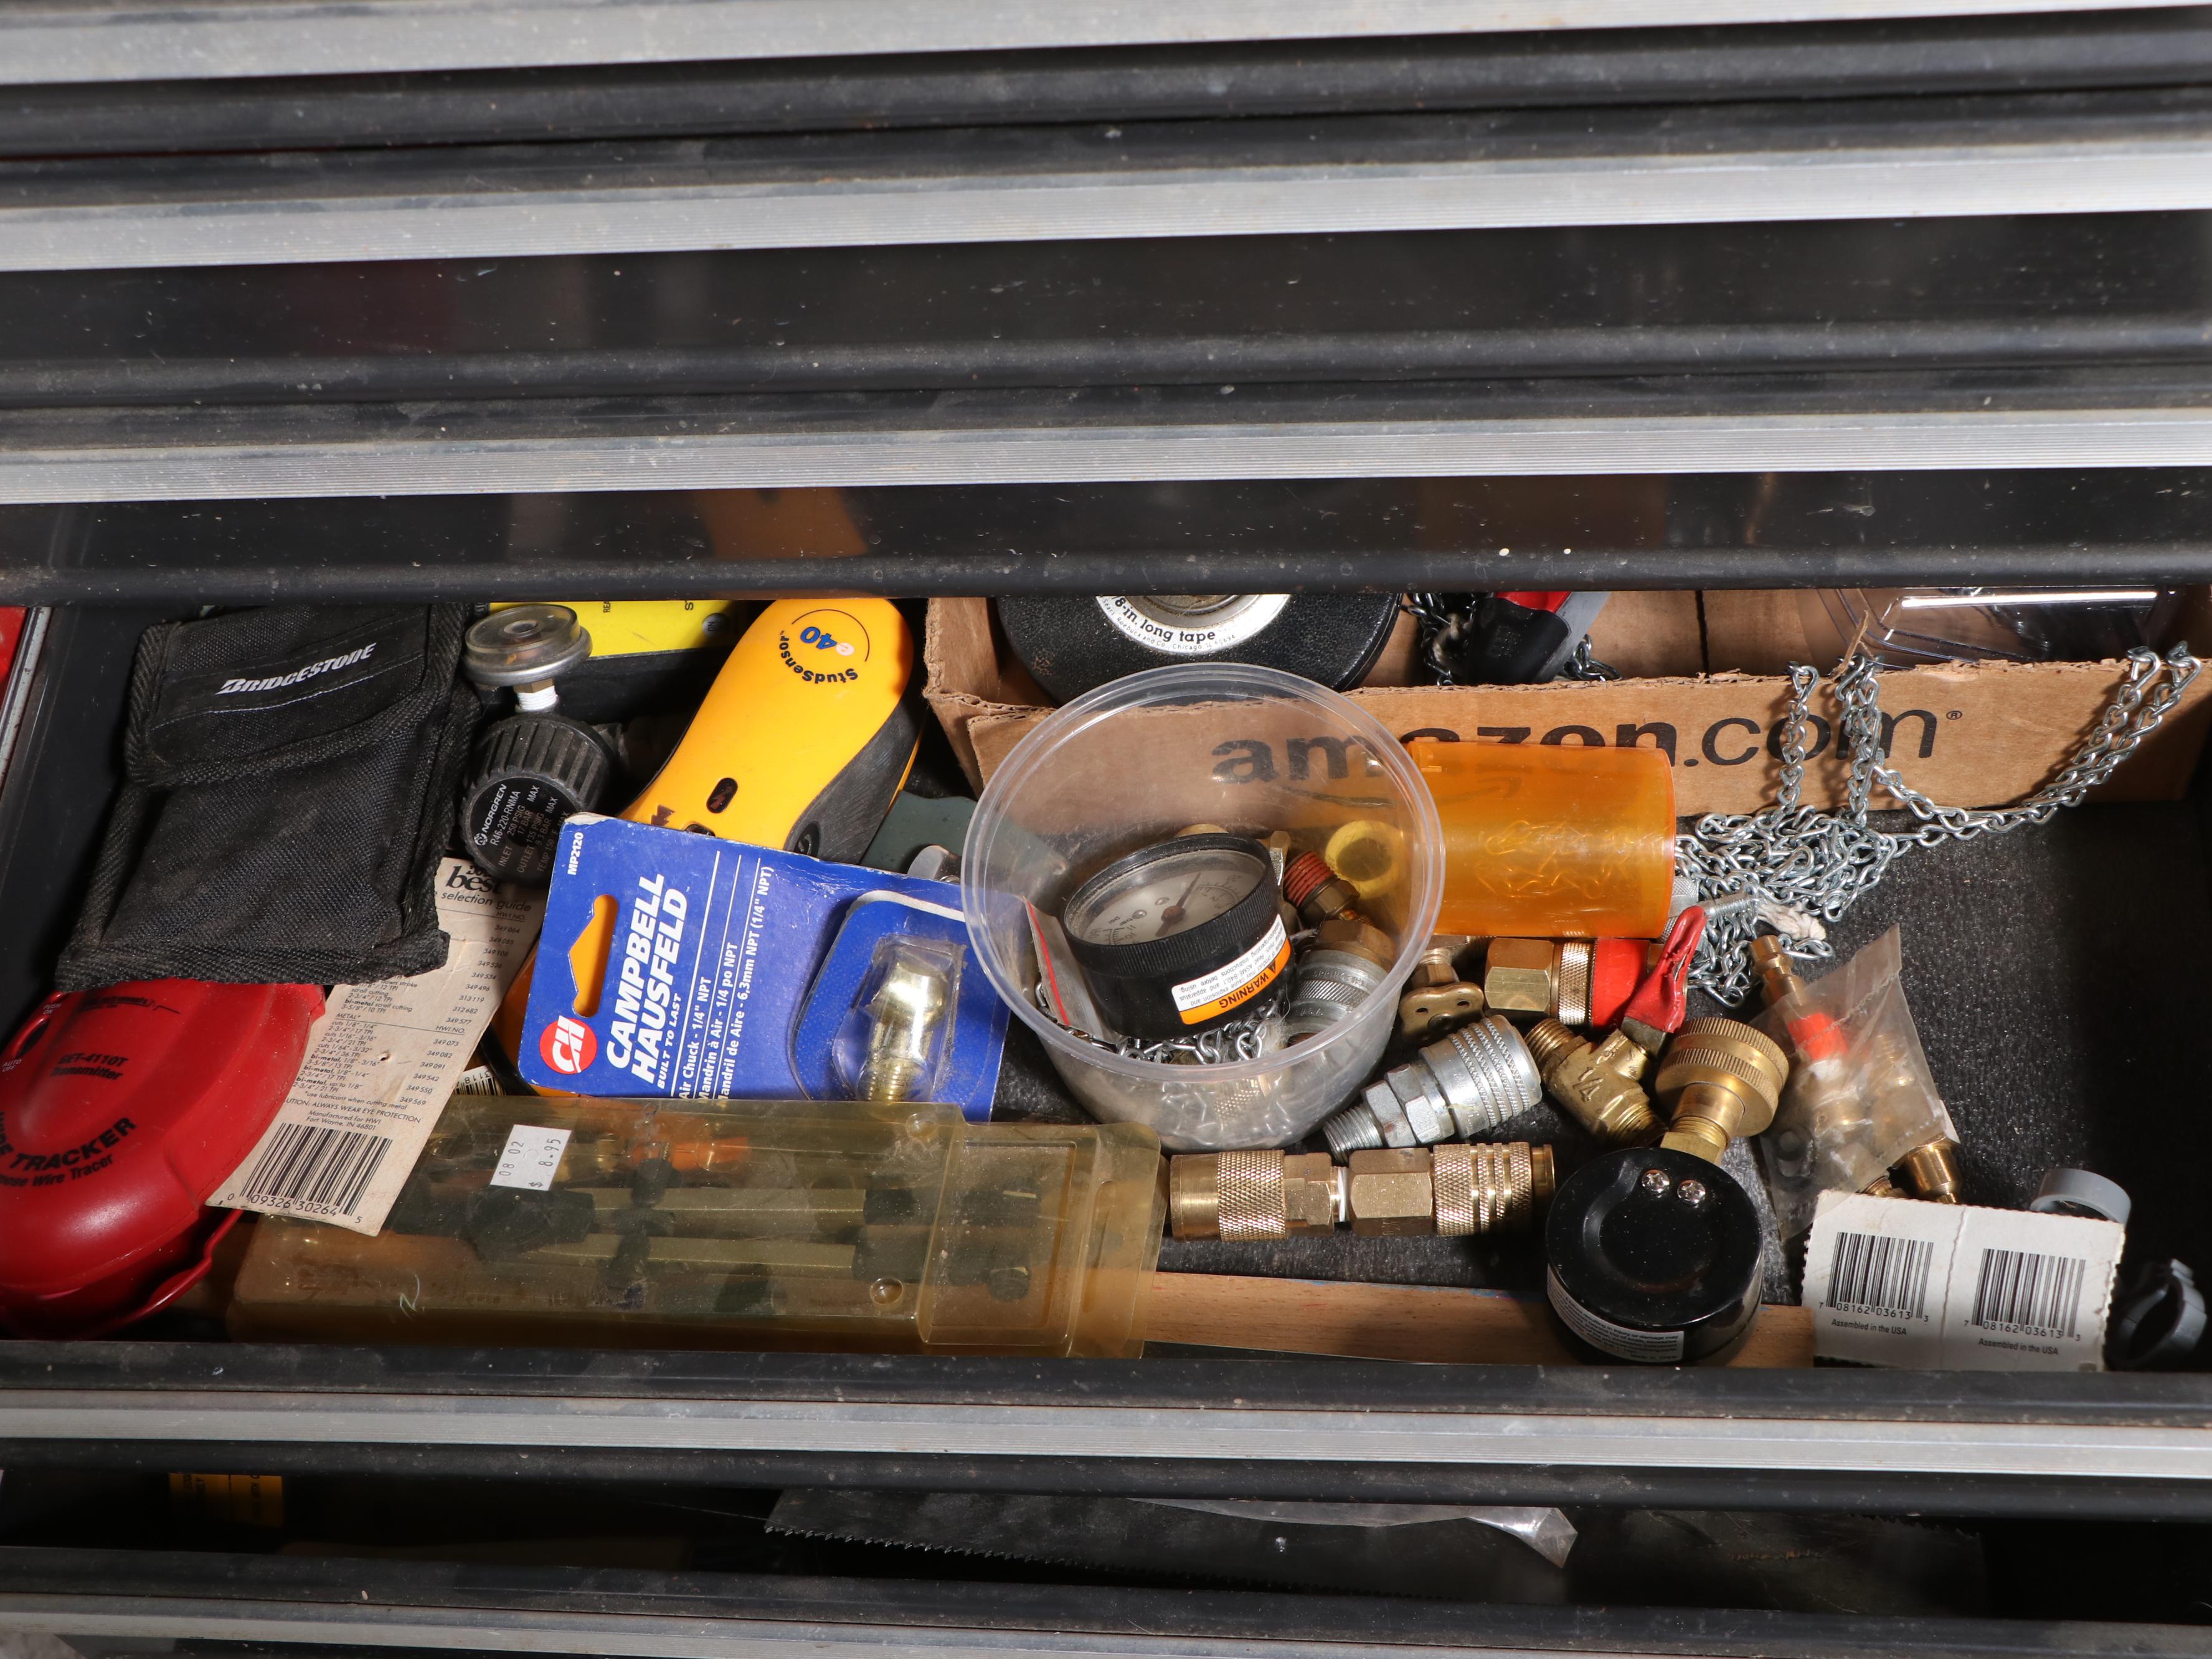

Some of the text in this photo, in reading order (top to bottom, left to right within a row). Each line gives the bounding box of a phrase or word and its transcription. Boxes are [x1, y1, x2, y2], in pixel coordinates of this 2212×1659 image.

[800, 626, 854, 656] e40
[1140, 618, 1173, 642] long
[1179, 631, 1216, 644] tape
[779, 635, 858, 684] StudSensor
[481, 783, 507, 833] NORGREN
[490, 791, 521, 846] R46-220-RNMA
[521, 811, 534, 826] BAR
[499, 785, 540, 867] INLET 250 PSIG MAX
[517, 846, 535, 873] OUTLET
[532, 813, 544, 831] PSIG
[545, 796, 558, 813] MAX
[540, 818, 552, 835] BAR
[567, 832, 584, 876] MP2120
[757, 866, 774, 896] NPT)
[441, 891, 531, 912] selection guide
[745, 930, 760, 956] NPT
[723, 942, 738, 968] NPT
[606, 873, 665, 1069] CAMPBELL
[722, 970, 734, 988] po
[737, 959, 755, 1000] 6,3mm
[1201, 976, 1218, 985] before
[631, 888, 688, 1084] HAUSFELD
[1209, 983, 1220, 991] and
[1219, 972, 1269, 1008] WARNING
[1231, 978, 1245, 988] cause
[716, 990, 729, 1007] 1/4
[1179, 989, 1207, 1001] apparatus
[1204, 988, 1229, 1001] explosion
[392, 1004, 413, 1013] cutting
[711, 1018, 723, 1039] Air
[730, 1011, 745, 1037] Aire
[657, 993, 681, 1090] BUILT TO LAST
[679, 976, 711, 1099] Air Chuck 1/4" NPT
[707, 1041, 719, 1049] à
[726, 1040, 739, 1056] de
[311, 1054, 342, 1062] bi-metal,
[303, 1065, 334, 1074] bi-metal,
[296, 1077, 327, 1085] bi-metal,
[318, 1092, 346, 1102] lubricant
[366, 1100, 387, 1109] cutting
[308, 1110, 353, 1122] Manufactured
[354, 1115, 364, 1123] for
[312, 1102, 338, 1110] ALWAYS
[341, 1105, 361, 1114] WEAR
[376, 1110, 422, 1123] PROTECTION
[9, 1117, 136, 1171] TRACKER
[70, 1154, 113, 1180] Tracer
[499, 1141, 524, 1176] 08 02
[250, 1194, 291, 1209] 09326
[296, 1201, 338, 1216] 30264
[1836, 1303, 1870, 1315] 08162
[1876, 1308, 1911, 1320] 03613
[1831, 1319, 1869, 1330] Assembled
[1891, 1327, 1907, 1335] USA
[1983, 1321, 2019, 1333] 08162
[2025, 1326, 2062, 1339] 03613
[1978, 1338, 2018, 1350] Assembled
[2028, 1345, 2040, 1353] the
[2042, 1346, 2059, 1355] USA
